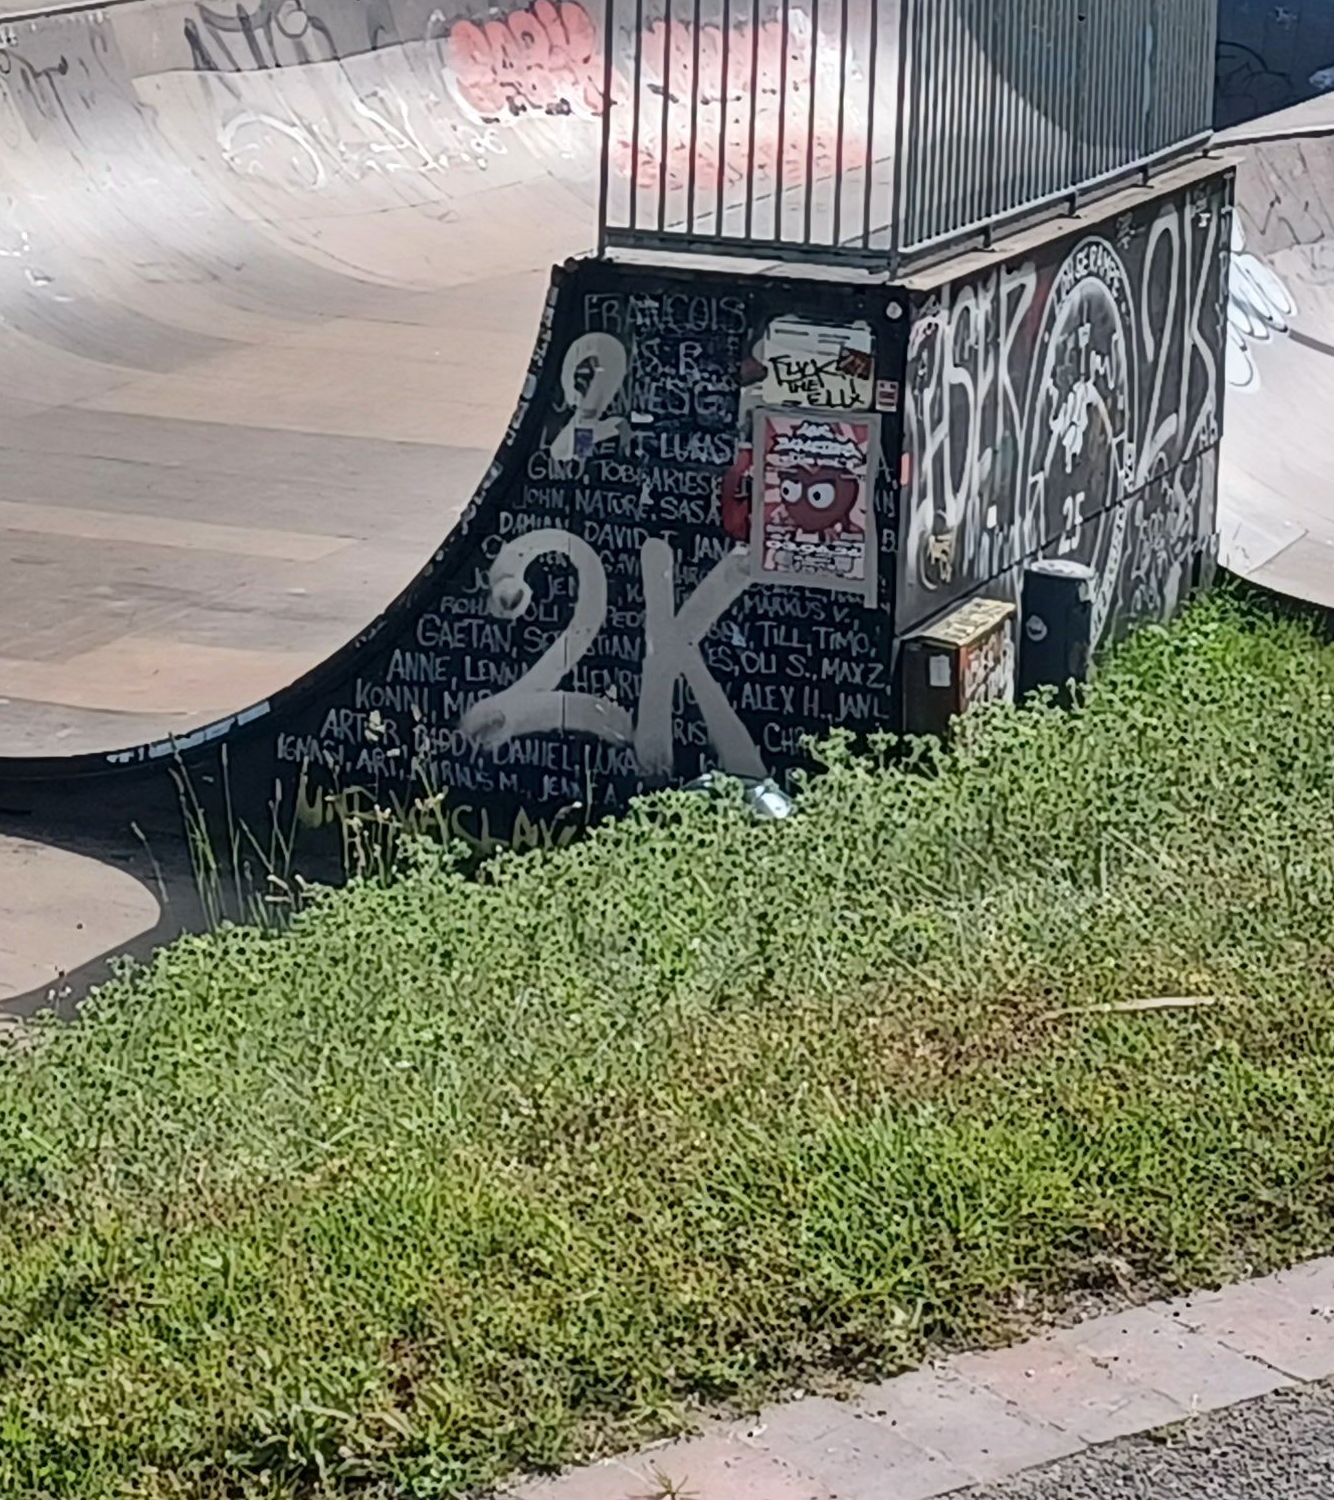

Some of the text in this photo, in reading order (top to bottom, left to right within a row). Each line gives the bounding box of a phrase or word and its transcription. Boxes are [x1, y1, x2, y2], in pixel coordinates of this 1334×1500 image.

[768, 354, 845, 388] FUCK
[457, 527, 771, 778] 2K
[754, 619, 813, 657] TILL,
[812, 626, 877, 658] TIMO,
[386, 648, 458, 691] ANNE,
